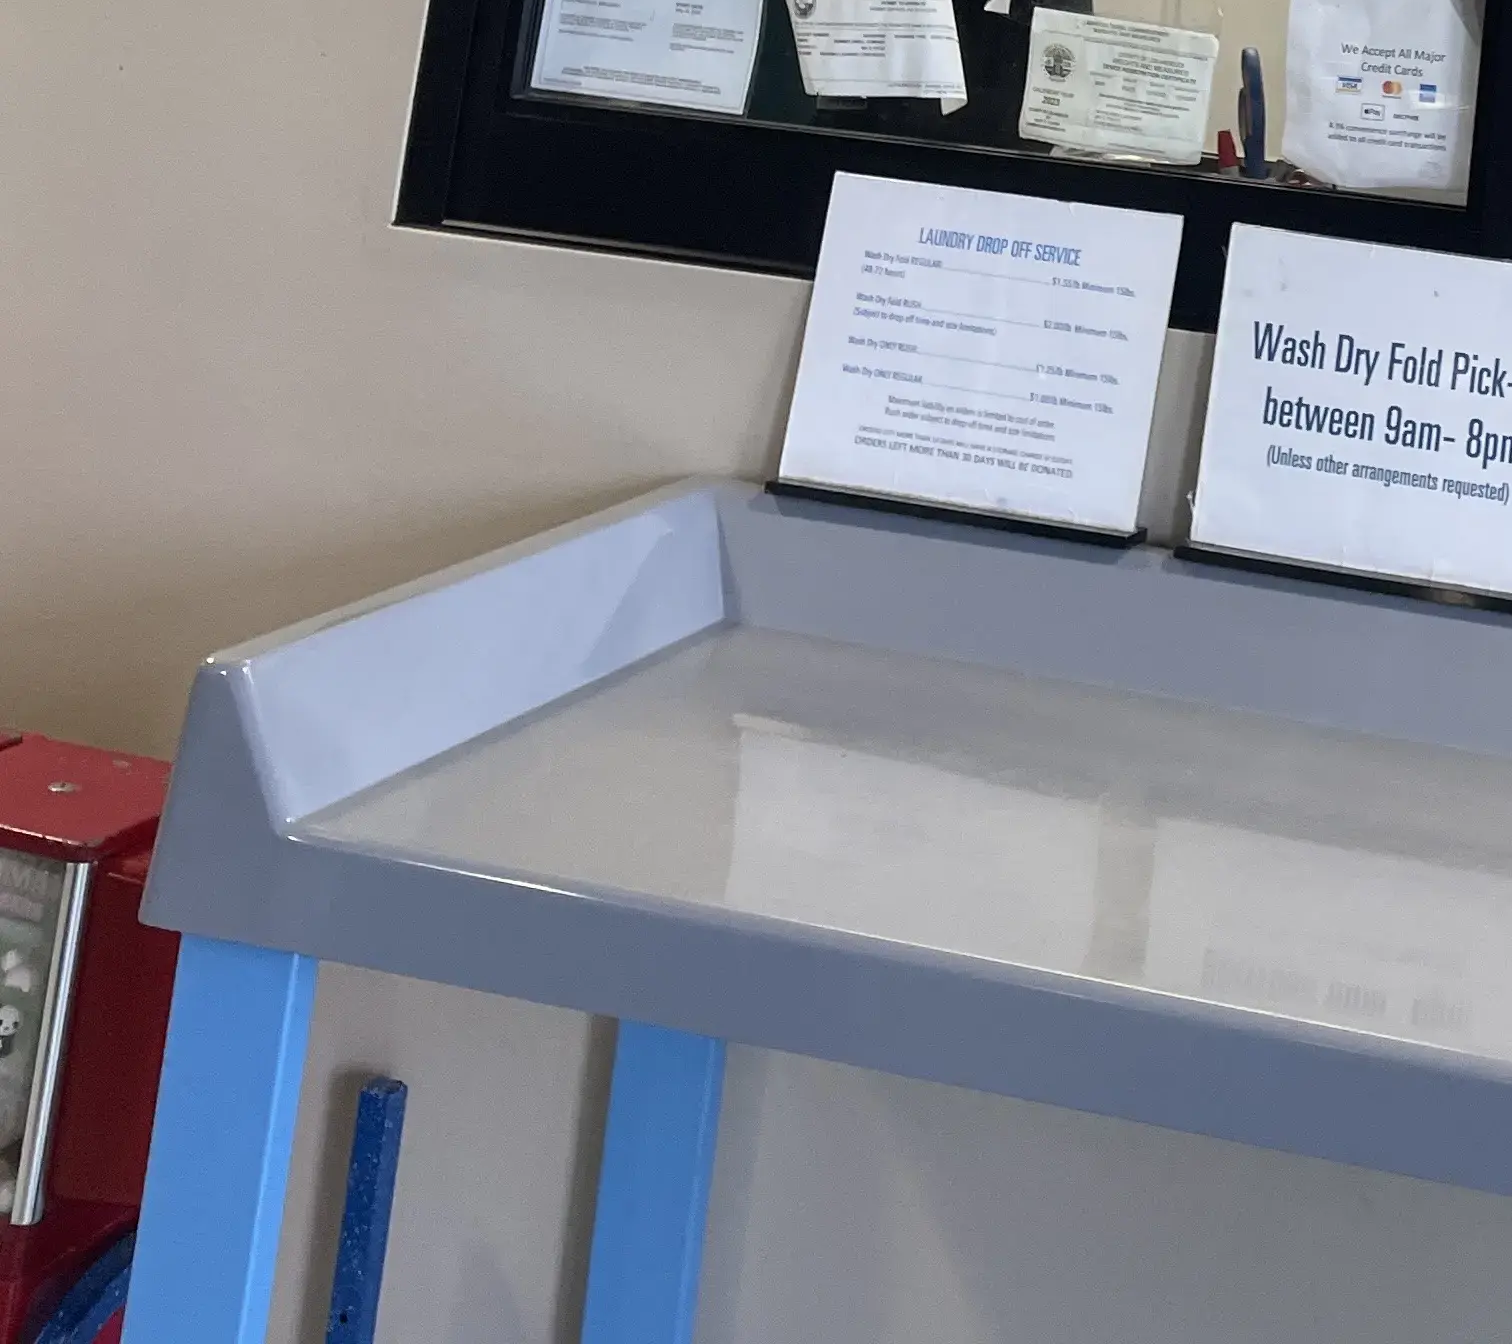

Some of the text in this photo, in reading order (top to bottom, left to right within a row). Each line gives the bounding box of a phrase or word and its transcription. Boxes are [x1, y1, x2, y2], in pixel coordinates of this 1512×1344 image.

[1341, 42, 1446, 64] We Accept All Major
[1361, 62, 1423, 77] Credit Cards
[918, 227, 1082, 266] LAUNDRY DROP OFF SERVICE
[1253, 320, 1325, 371] Wash
[1335, 333, 1380, 386] Dry
[1387, 341, 1445, 389] Fold
[1262, 386, 1375, 442] between
[1384, 405, 1456, 452] 9am-
[854, 435, 887, 449] ORDERS
[888, 441, 907, 452] LEFT
[909, 444, 934, 456] MORE
[937, 448, 959, 460] THAN
[973, 455, 995, 467] DAYS
[997, 458, 1015, 470] WILL
[1018, 462, 1028, 472] BE
[1031, 464, 1073, 479] DONATED
[1266, 444, 1511, 506] (Unless other arrangements requested)
